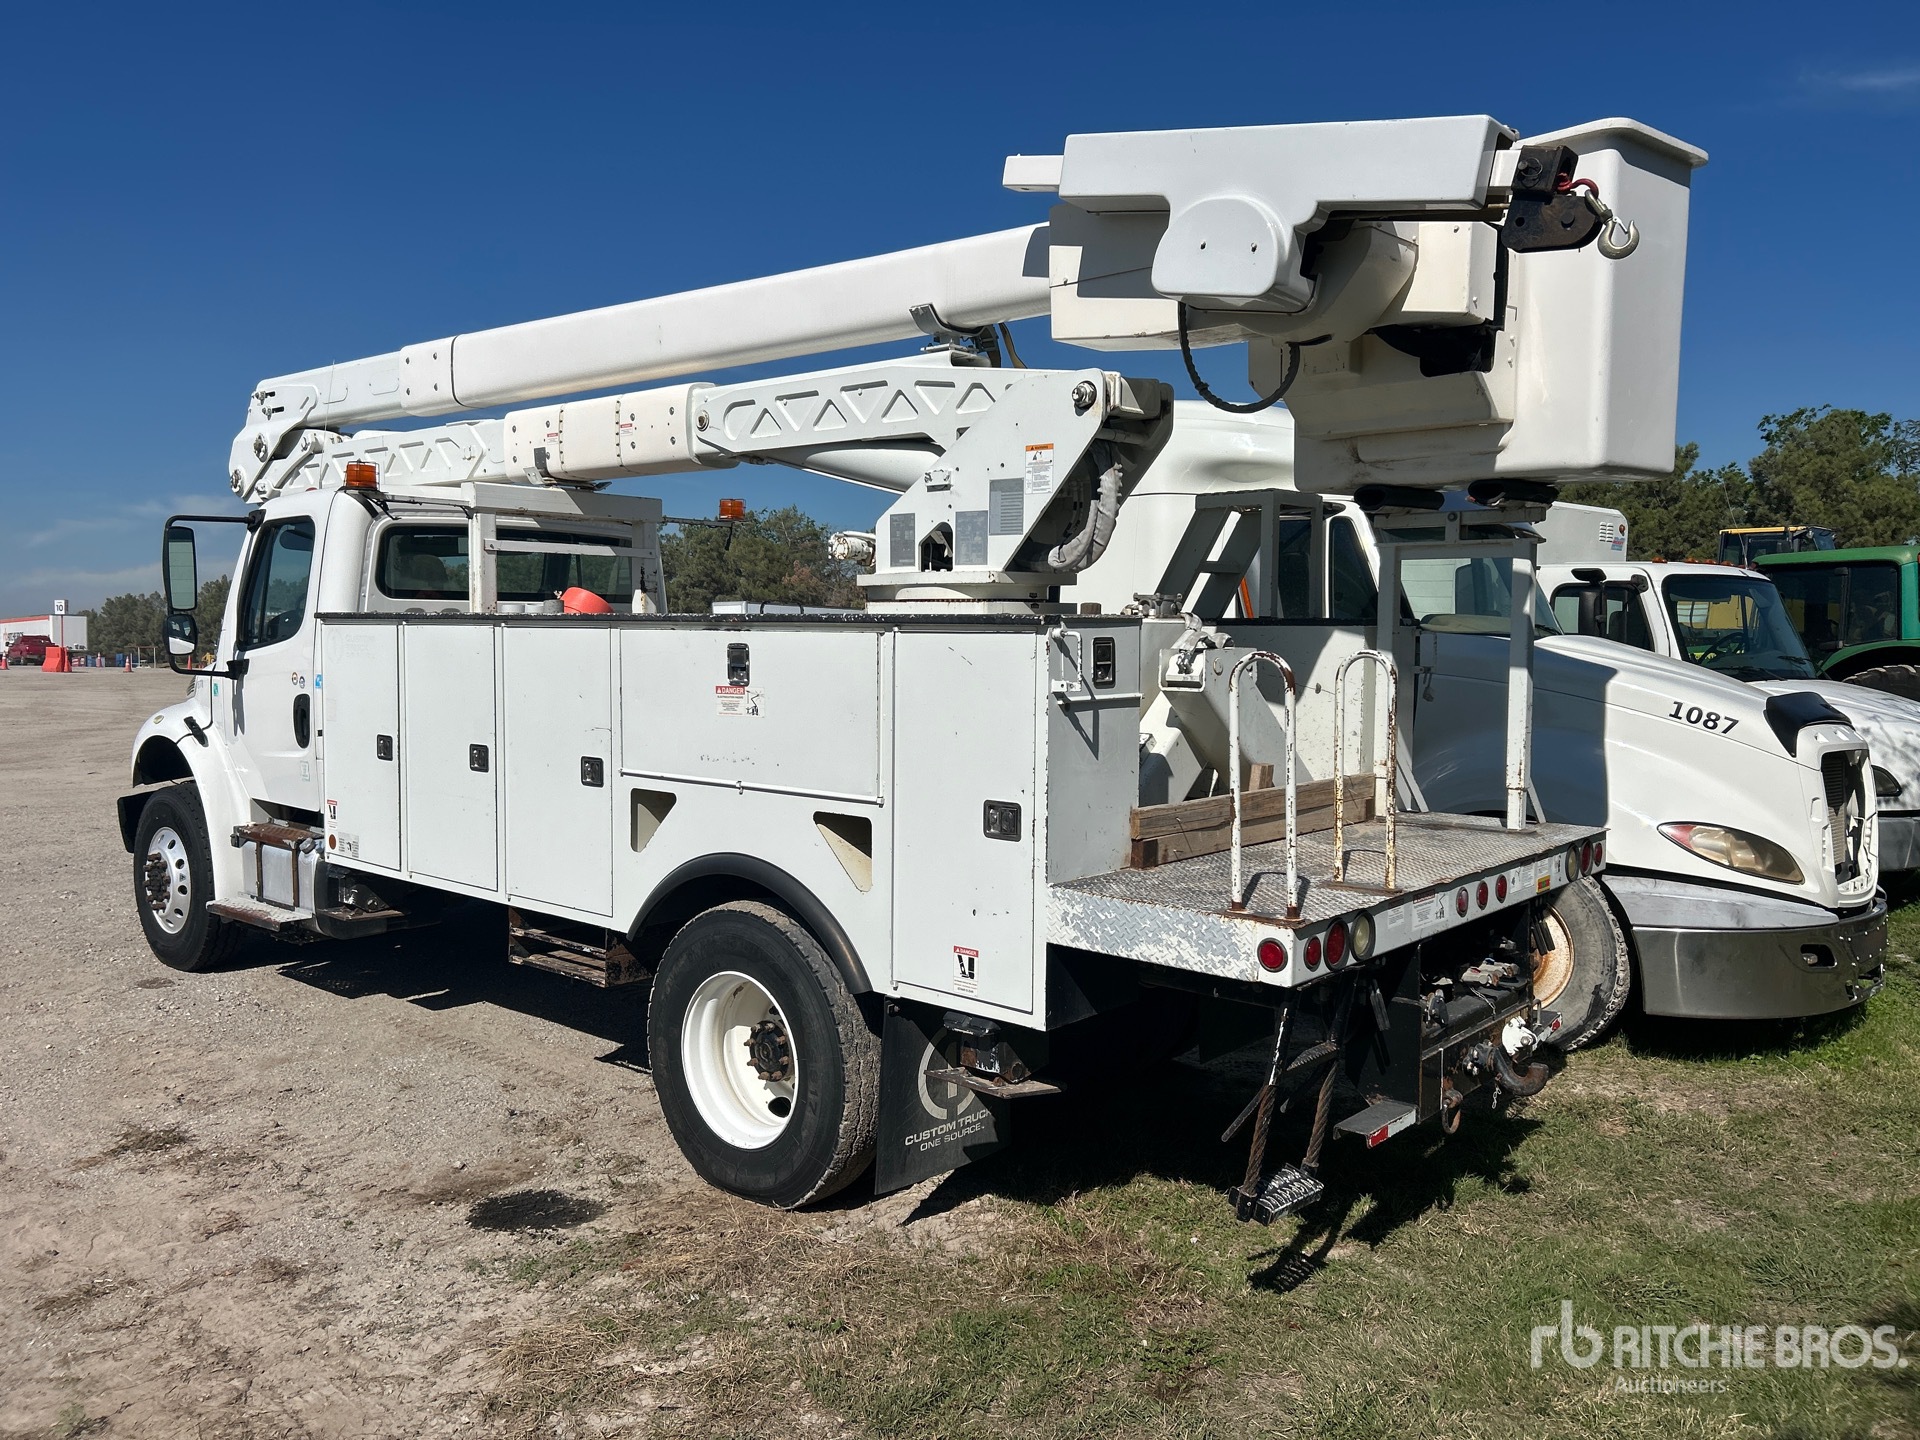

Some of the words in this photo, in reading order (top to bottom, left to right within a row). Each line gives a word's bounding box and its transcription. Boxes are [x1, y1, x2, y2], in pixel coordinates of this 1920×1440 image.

[55, 604, 64, 612] 10
[1668, 701, 1739, 735] 1087
[905, 1120, 957, 1146] CUSTOM
[920, 1137, 942, 1151] ONE
